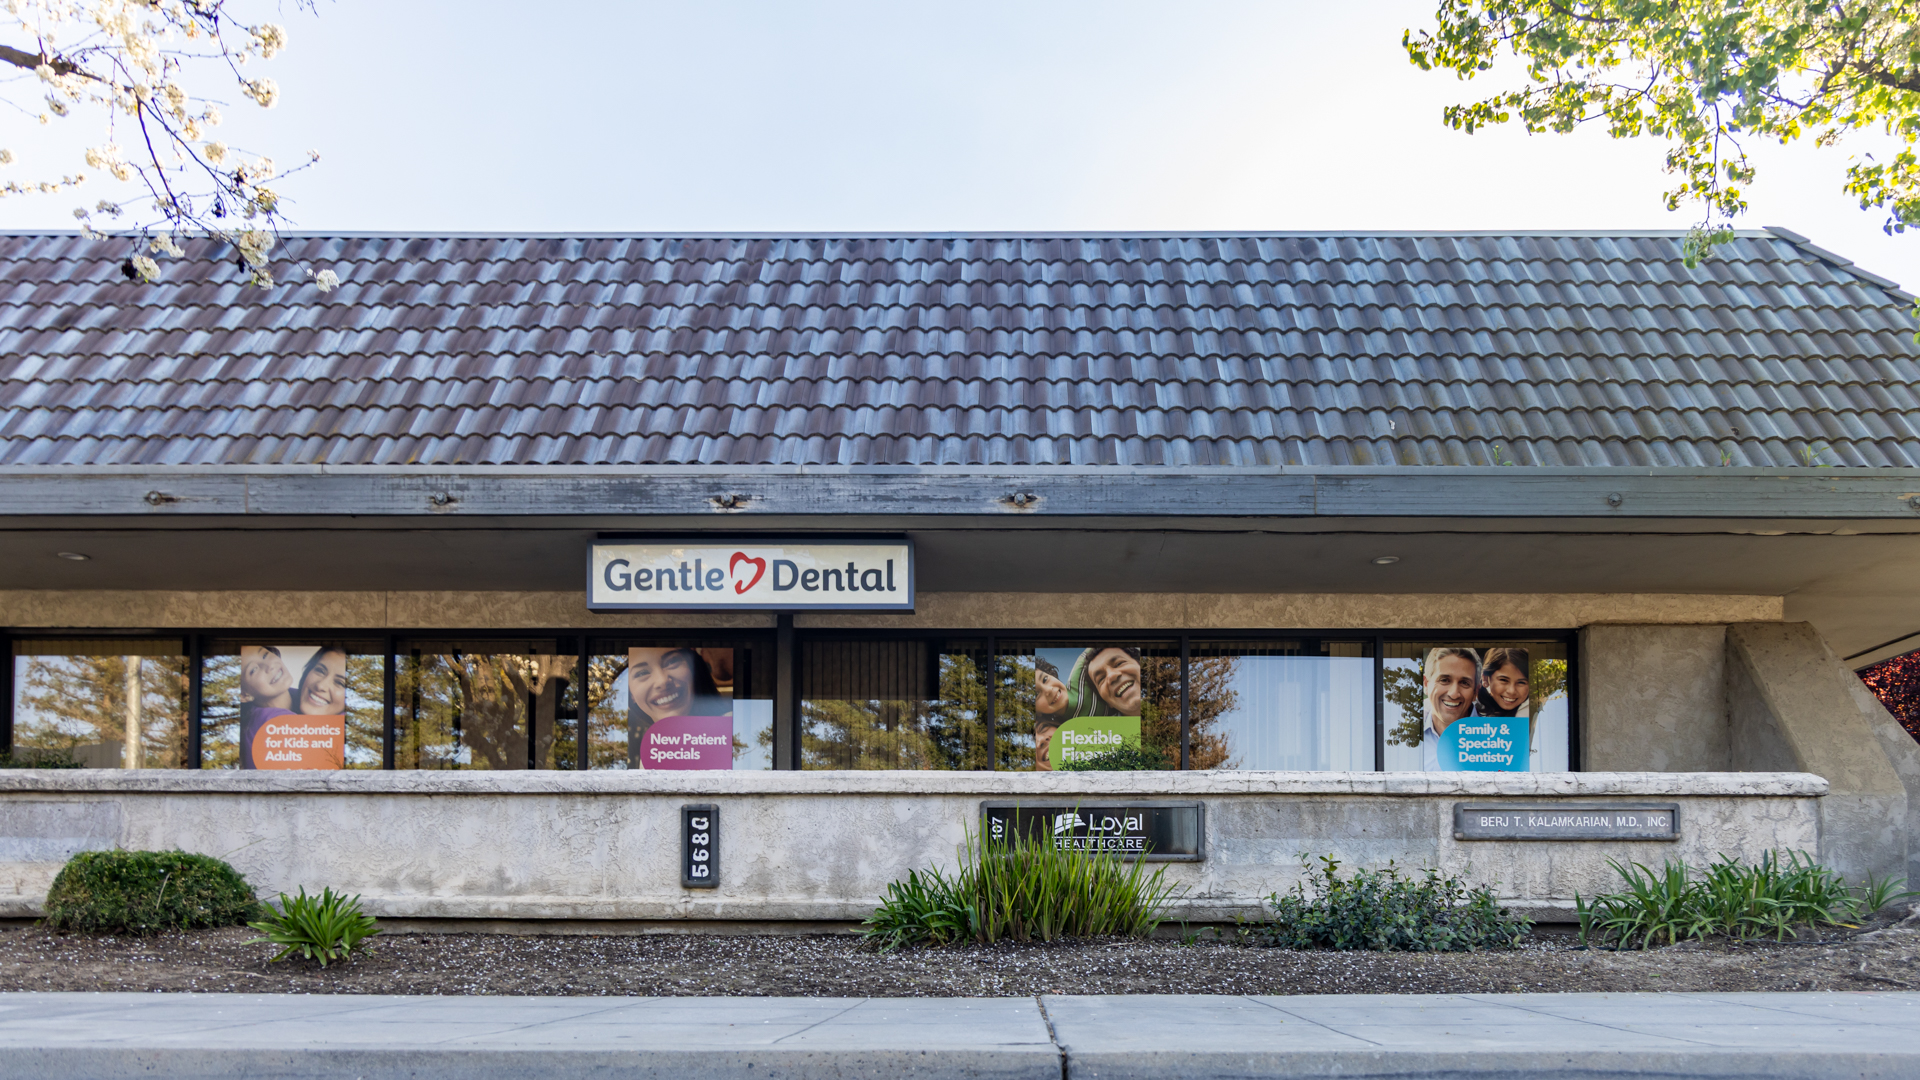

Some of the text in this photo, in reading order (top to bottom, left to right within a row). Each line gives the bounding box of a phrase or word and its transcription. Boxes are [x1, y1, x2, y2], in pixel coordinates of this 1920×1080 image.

[604, 558, 897, 592] Gentle Dental
[265, 724, 341, 736] Orthodontics
[1061, 729, 1122, 745] Flexible
[1458, 723, 1510, 738] Family &
[265, 737, 333, 749] for Kids and
[650, 733, 727, 746] New Patient
[1458, 737, 1513, 752] Specialty
[265, 750, 302, 762] Adults
[650, 747, 701, 762] Specials
[1458, 751, 1514, 766] Dentistry
[992, 816, 1003, 840] 107
[1089, 813, 1143, 836] Loyal
[1480, 816, 1669, 829] BERJ T. KALAMKARIAN, M.D., INC.
[691, 817, 710, 878] 5680
[1054, 839, 1143, 849] HEALTHCARE
